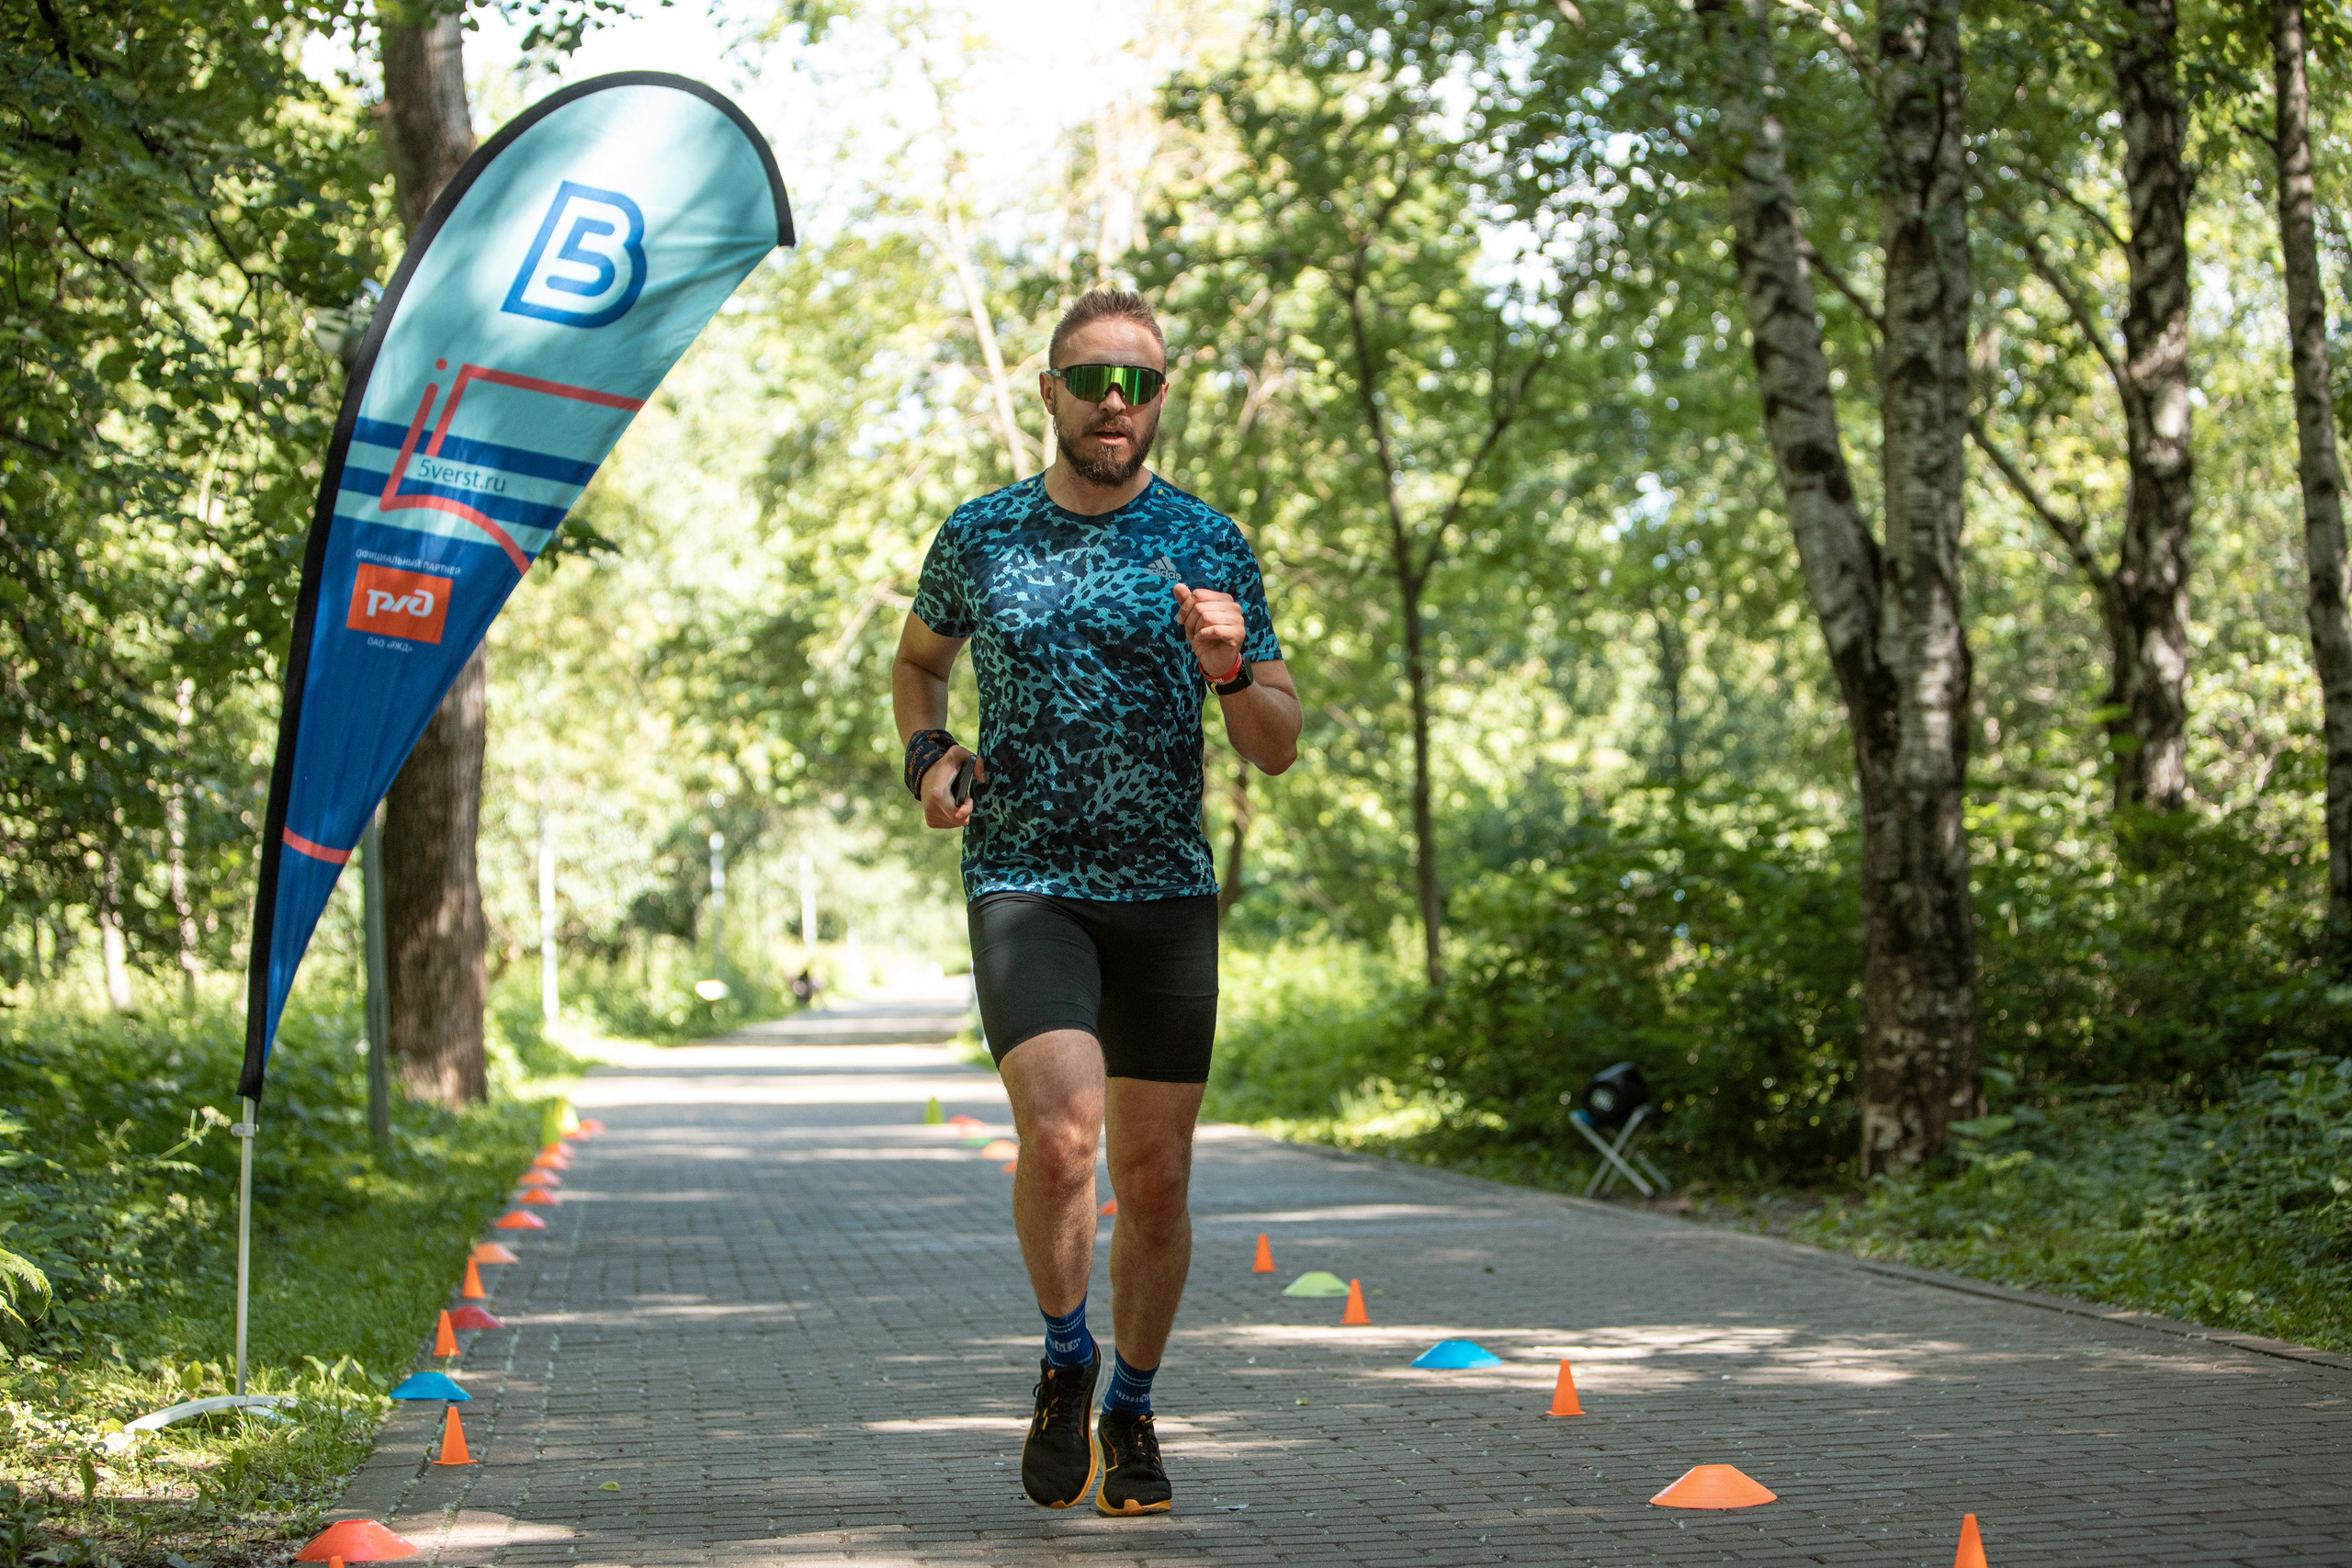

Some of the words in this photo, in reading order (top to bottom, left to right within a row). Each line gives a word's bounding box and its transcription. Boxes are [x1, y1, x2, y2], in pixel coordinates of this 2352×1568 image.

[418, 458, 506, 493] 5verst.ru
[356, 548, 422, 569] ОФИЦИАЛЬНЫЙ
[424, 560, 461, 575] ПАРТНЕР
[1143, 567, 1182, 581] adidas
[368, 637, 385, 649] ОАО
